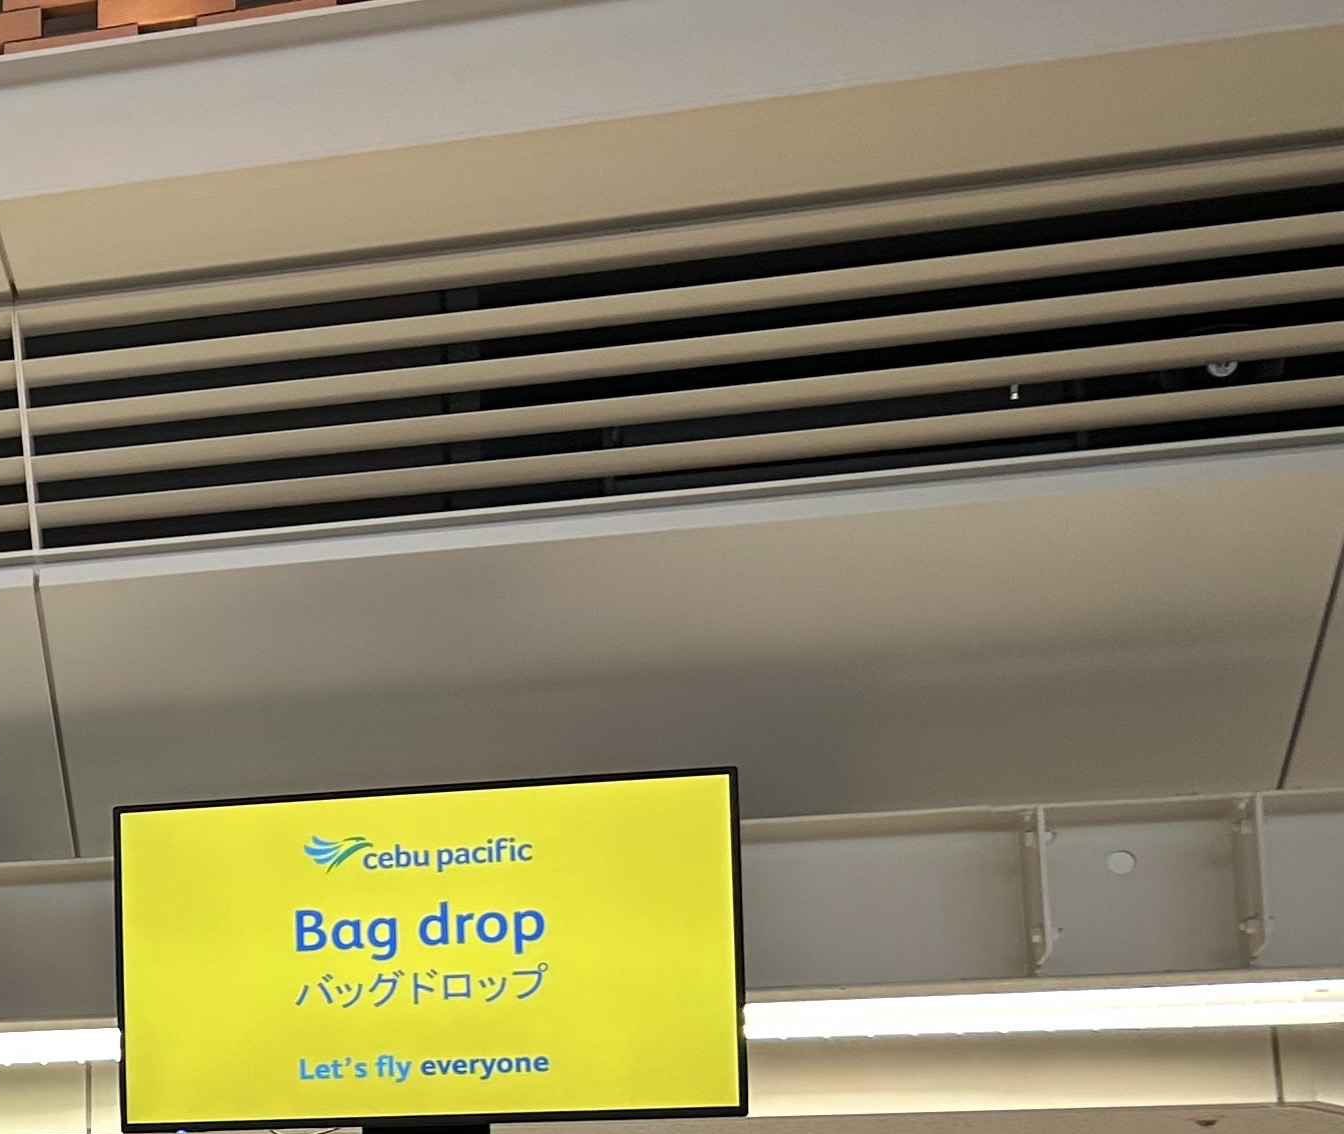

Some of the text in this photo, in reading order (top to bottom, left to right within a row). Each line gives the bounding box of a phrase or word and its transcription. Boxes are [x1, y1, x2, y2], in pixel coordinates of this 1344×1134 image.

[362, 837, 533, 872] cebu pacific
[294, 902, 546, 960] Bag drop
[295, 963, 549, 1009] バッグドロップ
[299, 1052, 549, 1083] Let's fly everyone
